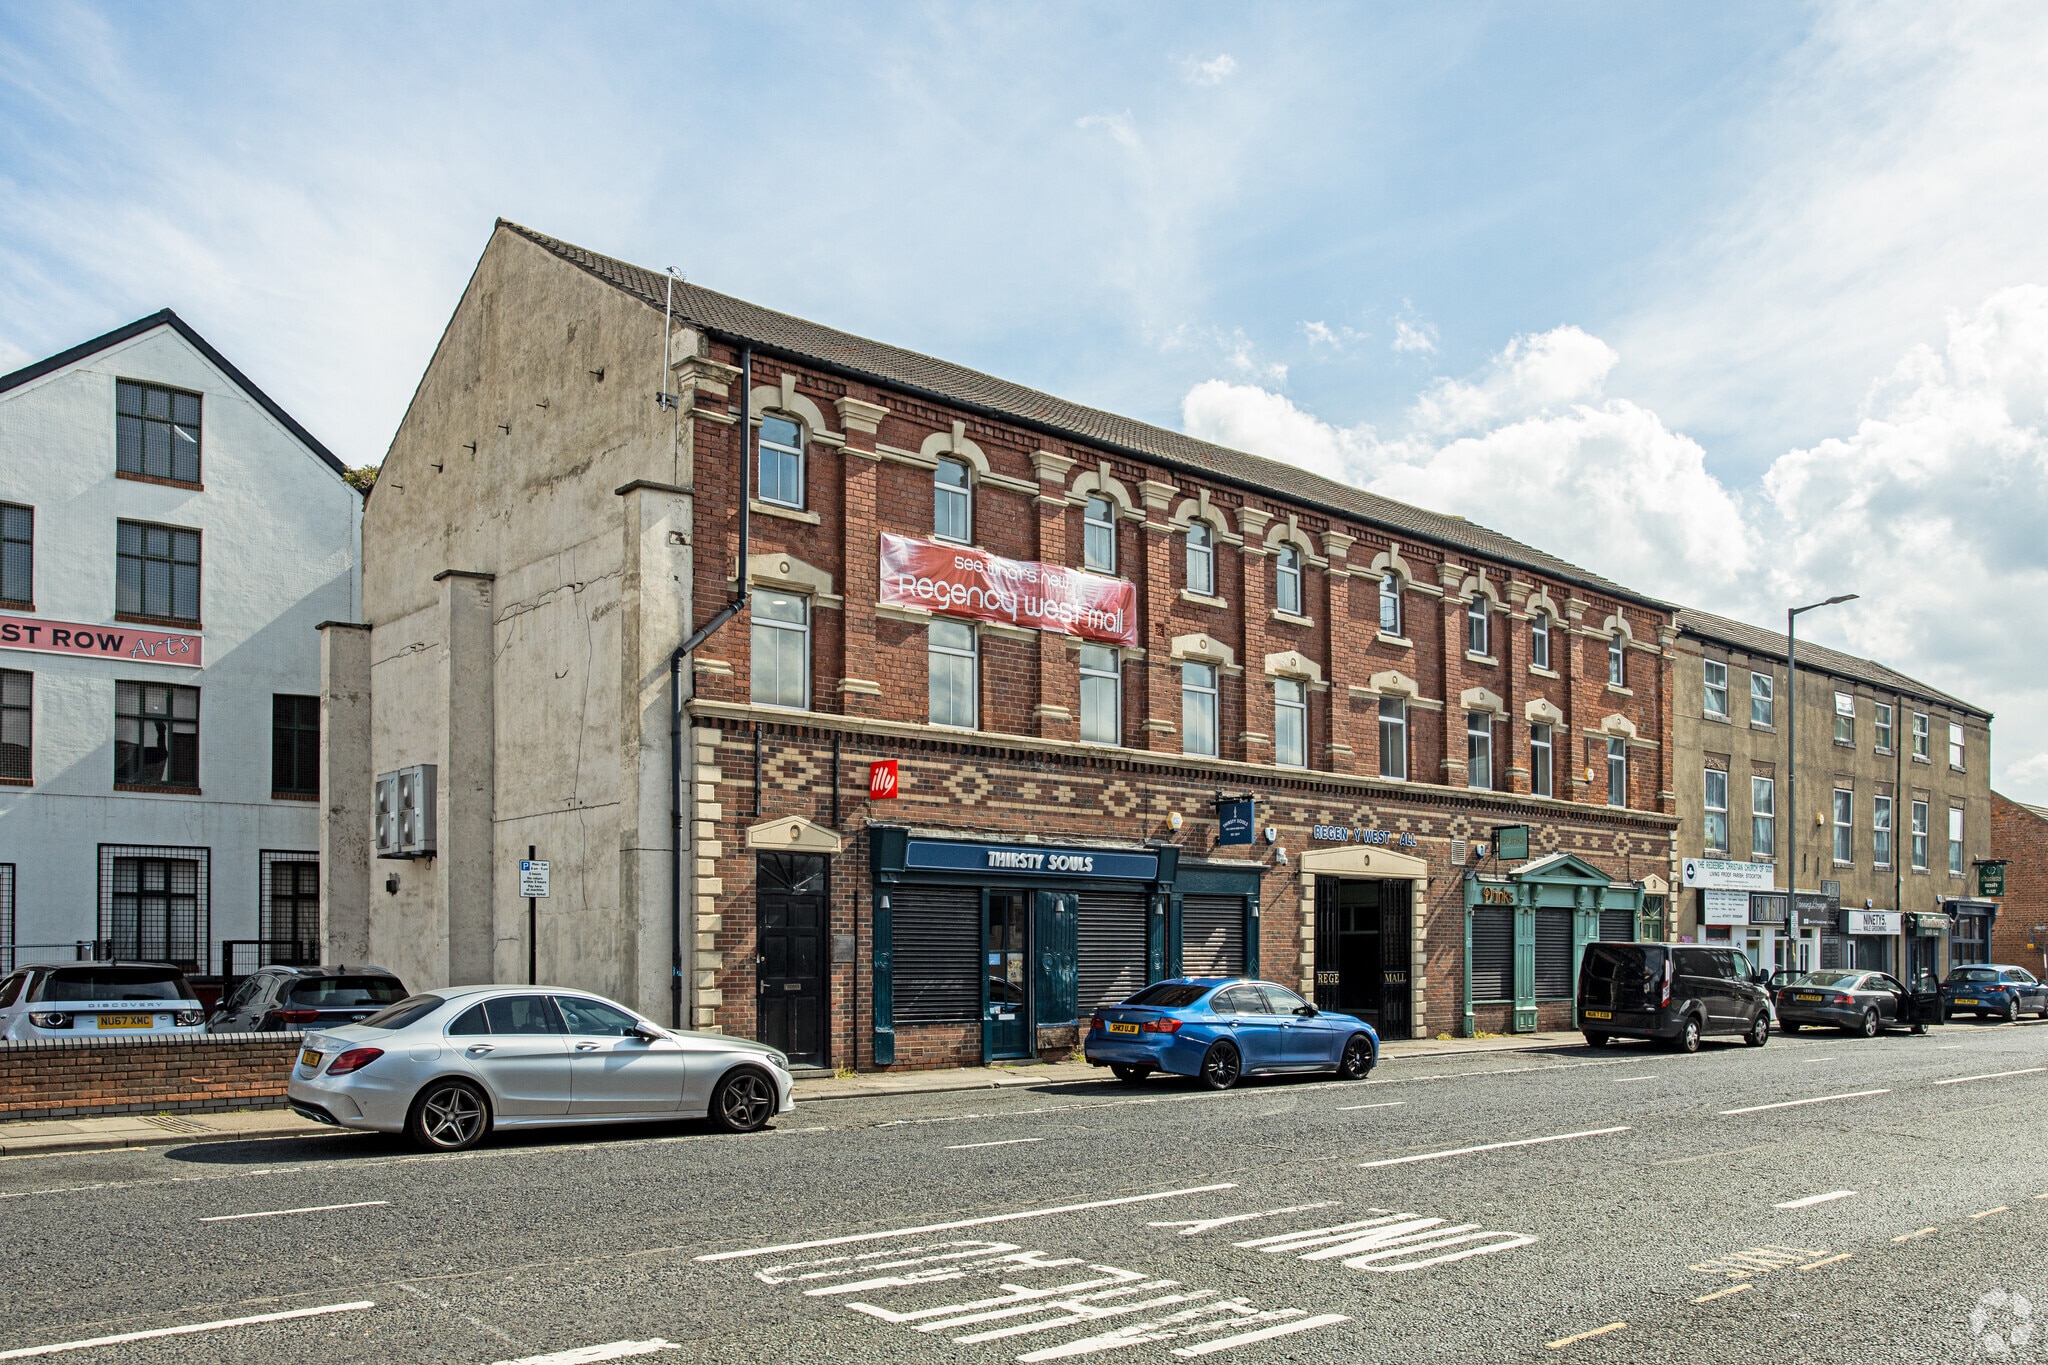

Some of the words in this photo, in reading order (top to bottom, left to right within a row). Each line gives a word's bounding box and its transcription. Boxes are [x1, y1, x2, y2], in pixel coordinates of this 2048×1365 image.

[954, 556, 983, 572] see
[900, 573, 1017, 622] Regency
[1024, 594, 1079, 625] west
[1088, 607, 1124, 634] mall
[52, 630, 124, 652] ROW
[130, 636, 194, 659] Arts
[872, 766, 896, 796] illy
[1363, 830, 1391, 845] WEST
[988, 850, 1044, 870] THIRSTY
[1048, 854, 1094, 872] SOULS
[1706, 861, 1724, 870] REDEEMED
[1726, 862, 1743, 871] CHRISTIAN
[1744, 864, 1758, 872] CHURCH
[1384, 973, 1406, 982] MALL
[101, 1015, 127, 1026] NU67
[130, 1016, 150, 1025] XMC
[754, 1240, 1352, 1364] AHEAD
